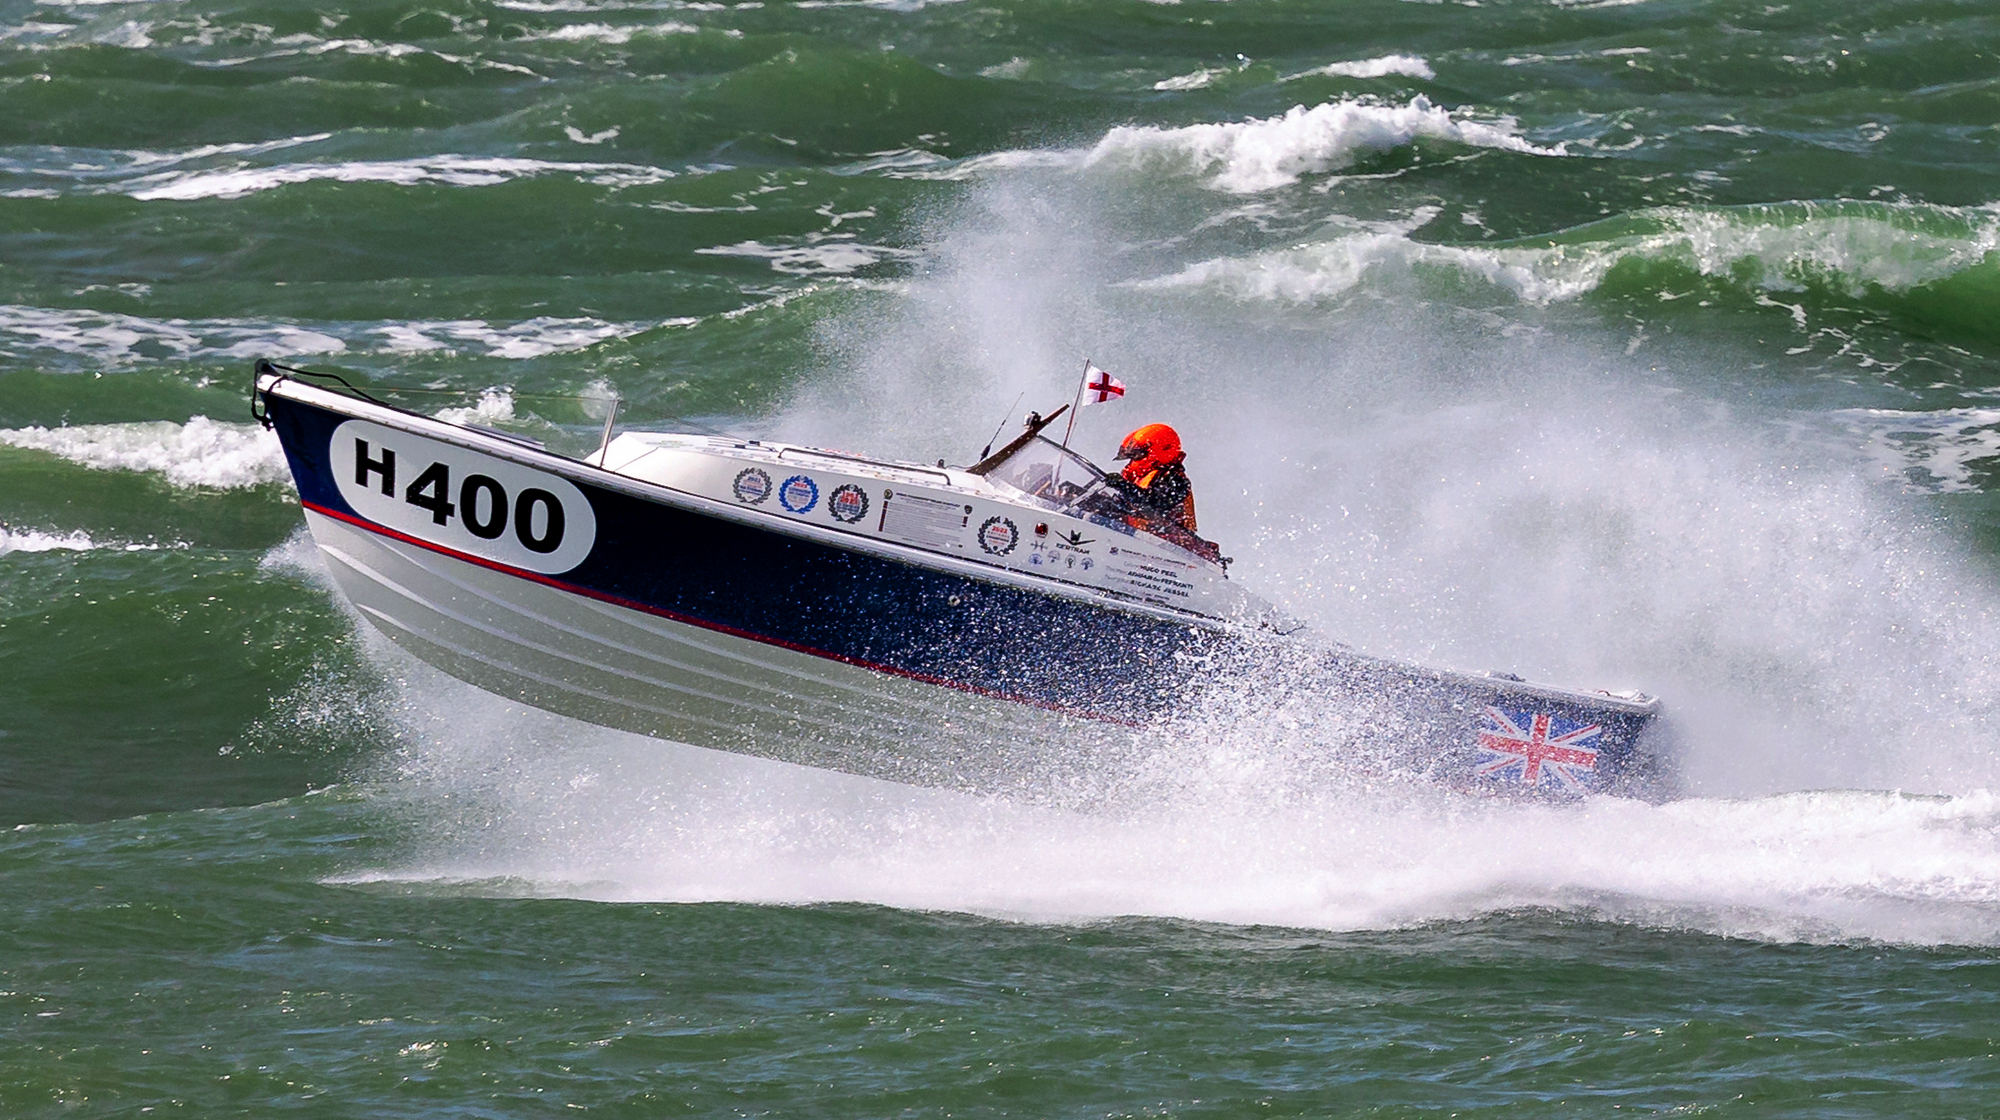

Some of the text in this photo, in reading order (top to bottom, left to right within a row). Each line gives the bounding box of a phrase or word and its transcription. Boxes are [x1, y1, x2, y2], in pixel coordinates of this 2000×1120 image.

[355, 437, 565, 554] H 400
[1055, 543, 1090, 555] BERTRAM
[1140, 565, 1178, 578] HUGO PEEL
